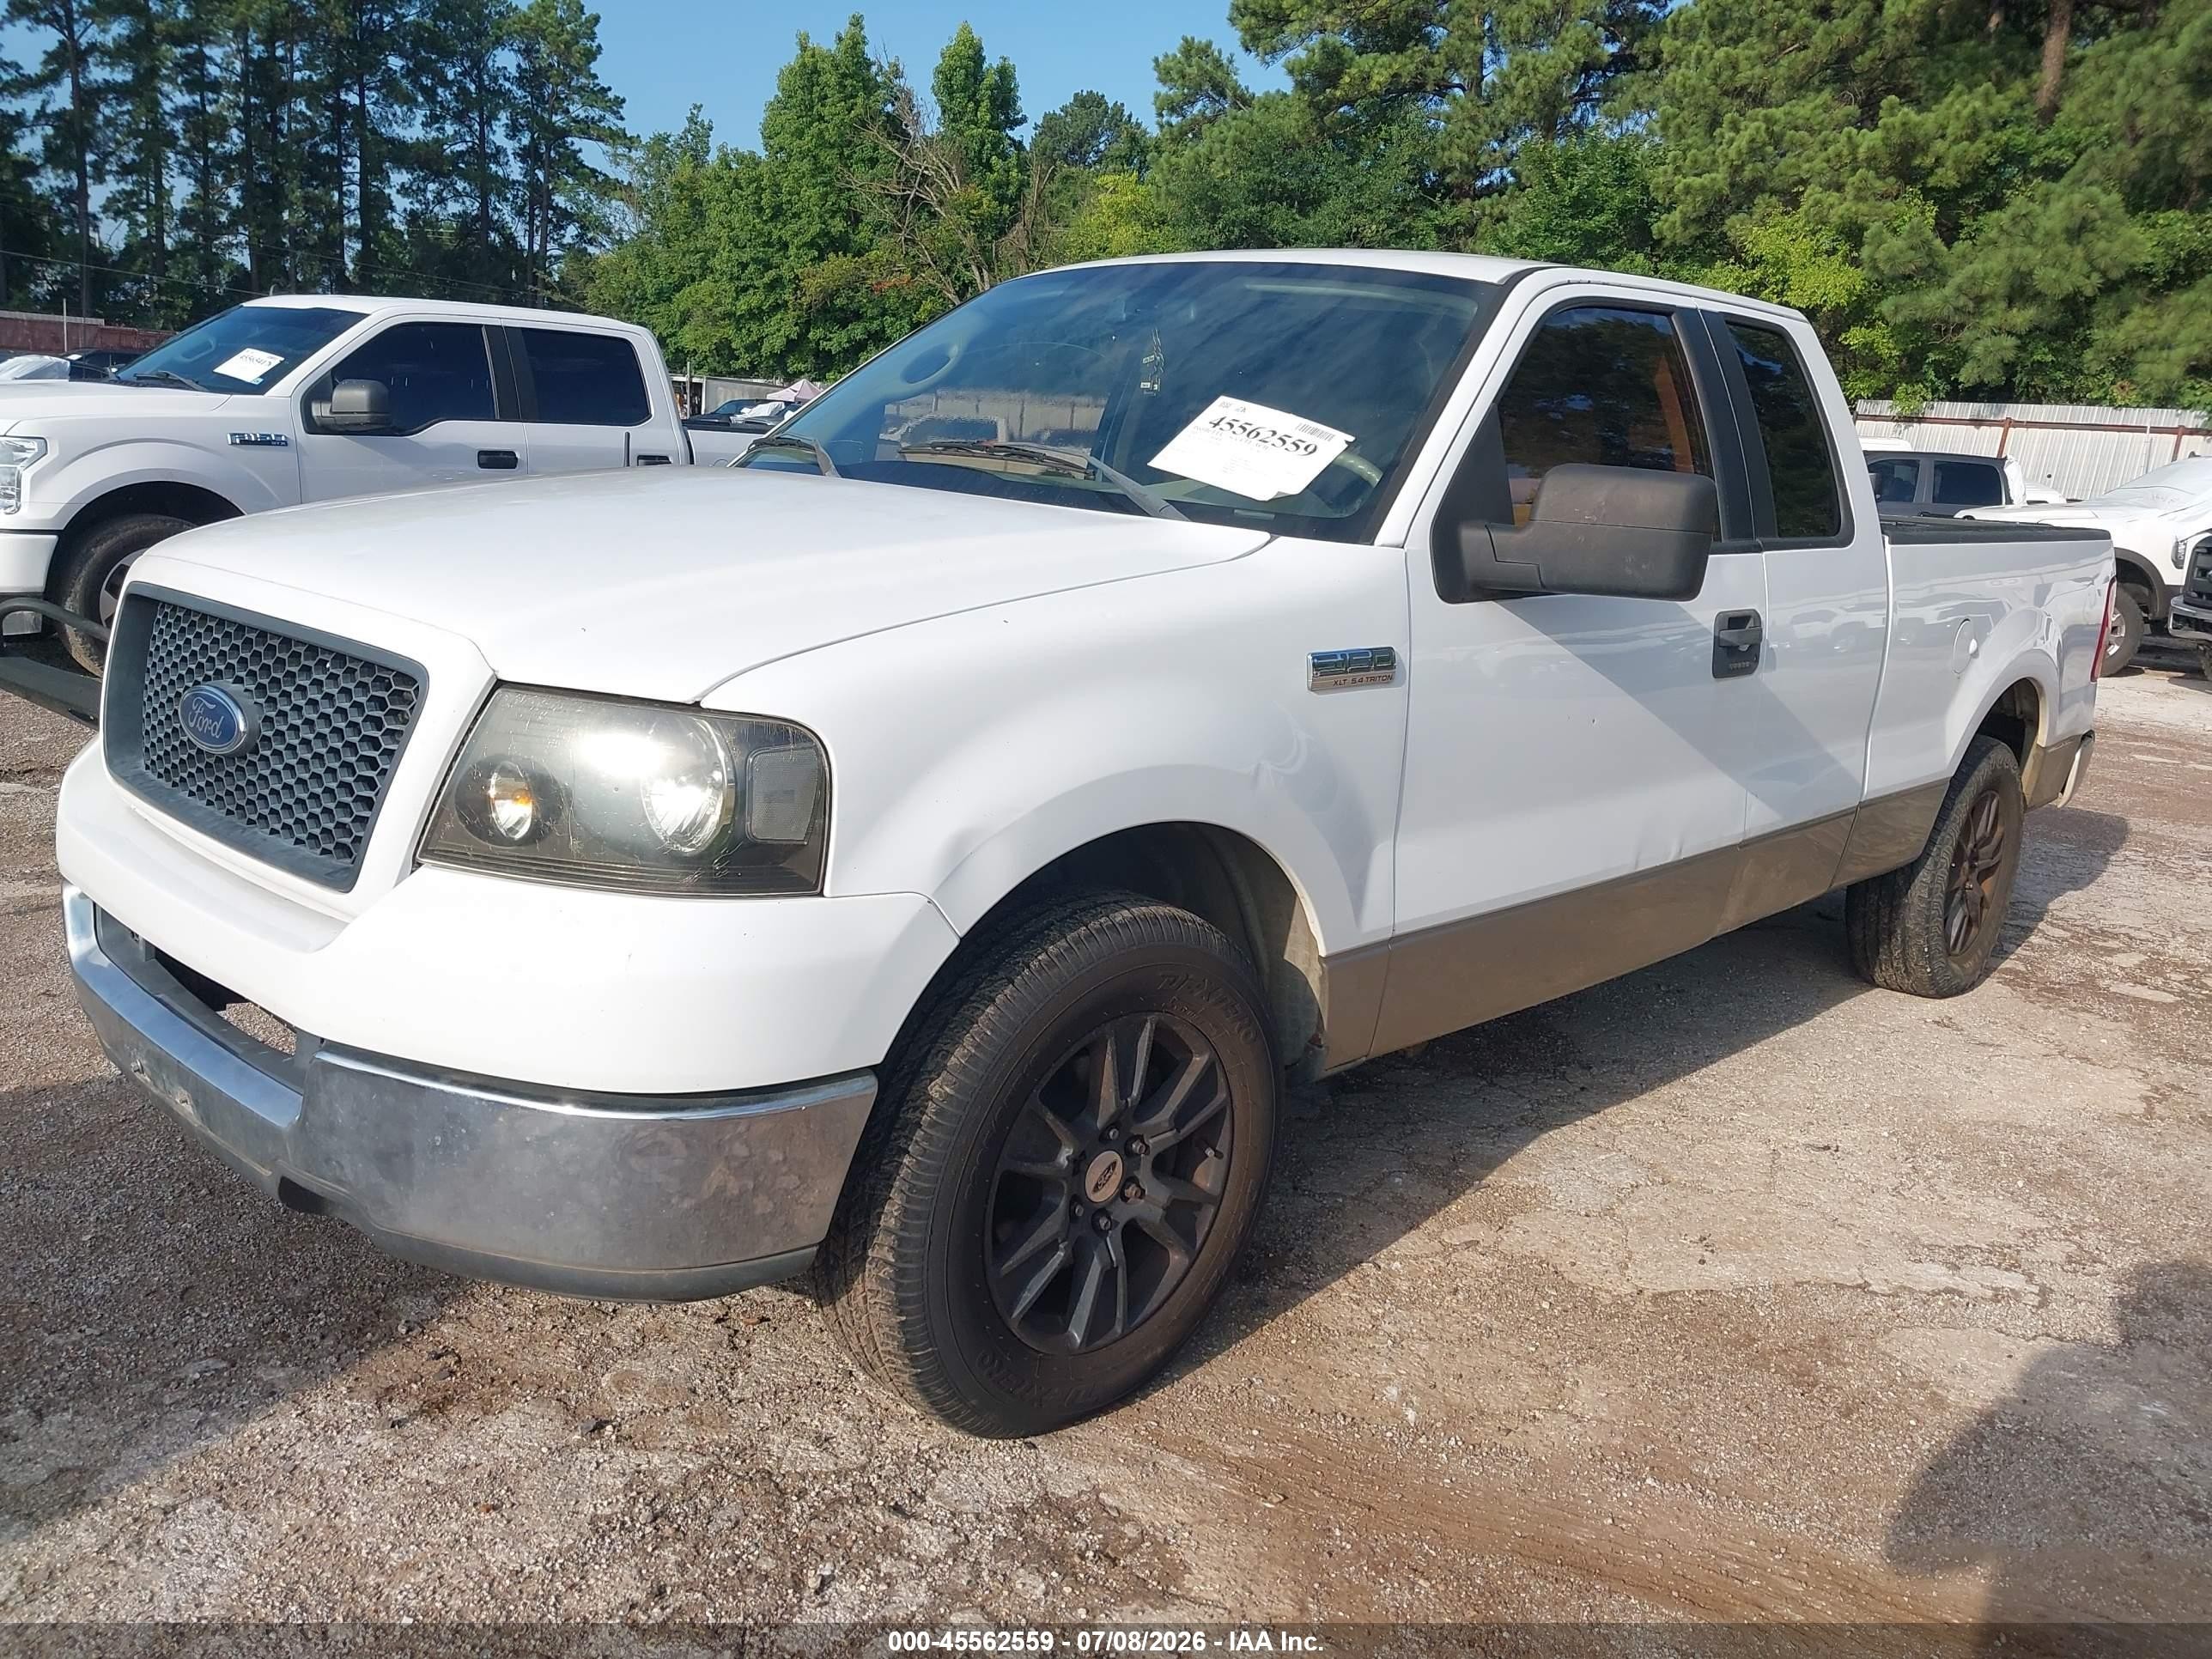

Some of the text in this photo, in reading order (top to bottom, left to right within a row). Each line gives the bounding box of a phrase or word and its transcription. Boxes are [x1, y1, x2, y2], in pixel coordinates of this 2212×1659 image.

[1209, 416, 1318, 457] 45562559
[1333, 678, 1347, 687] XLT
[1365, 674, 1394, 683] TRITON
[188, 696, 225, 739] Ford
[1097, 1164, 1114, 1190] Ford
